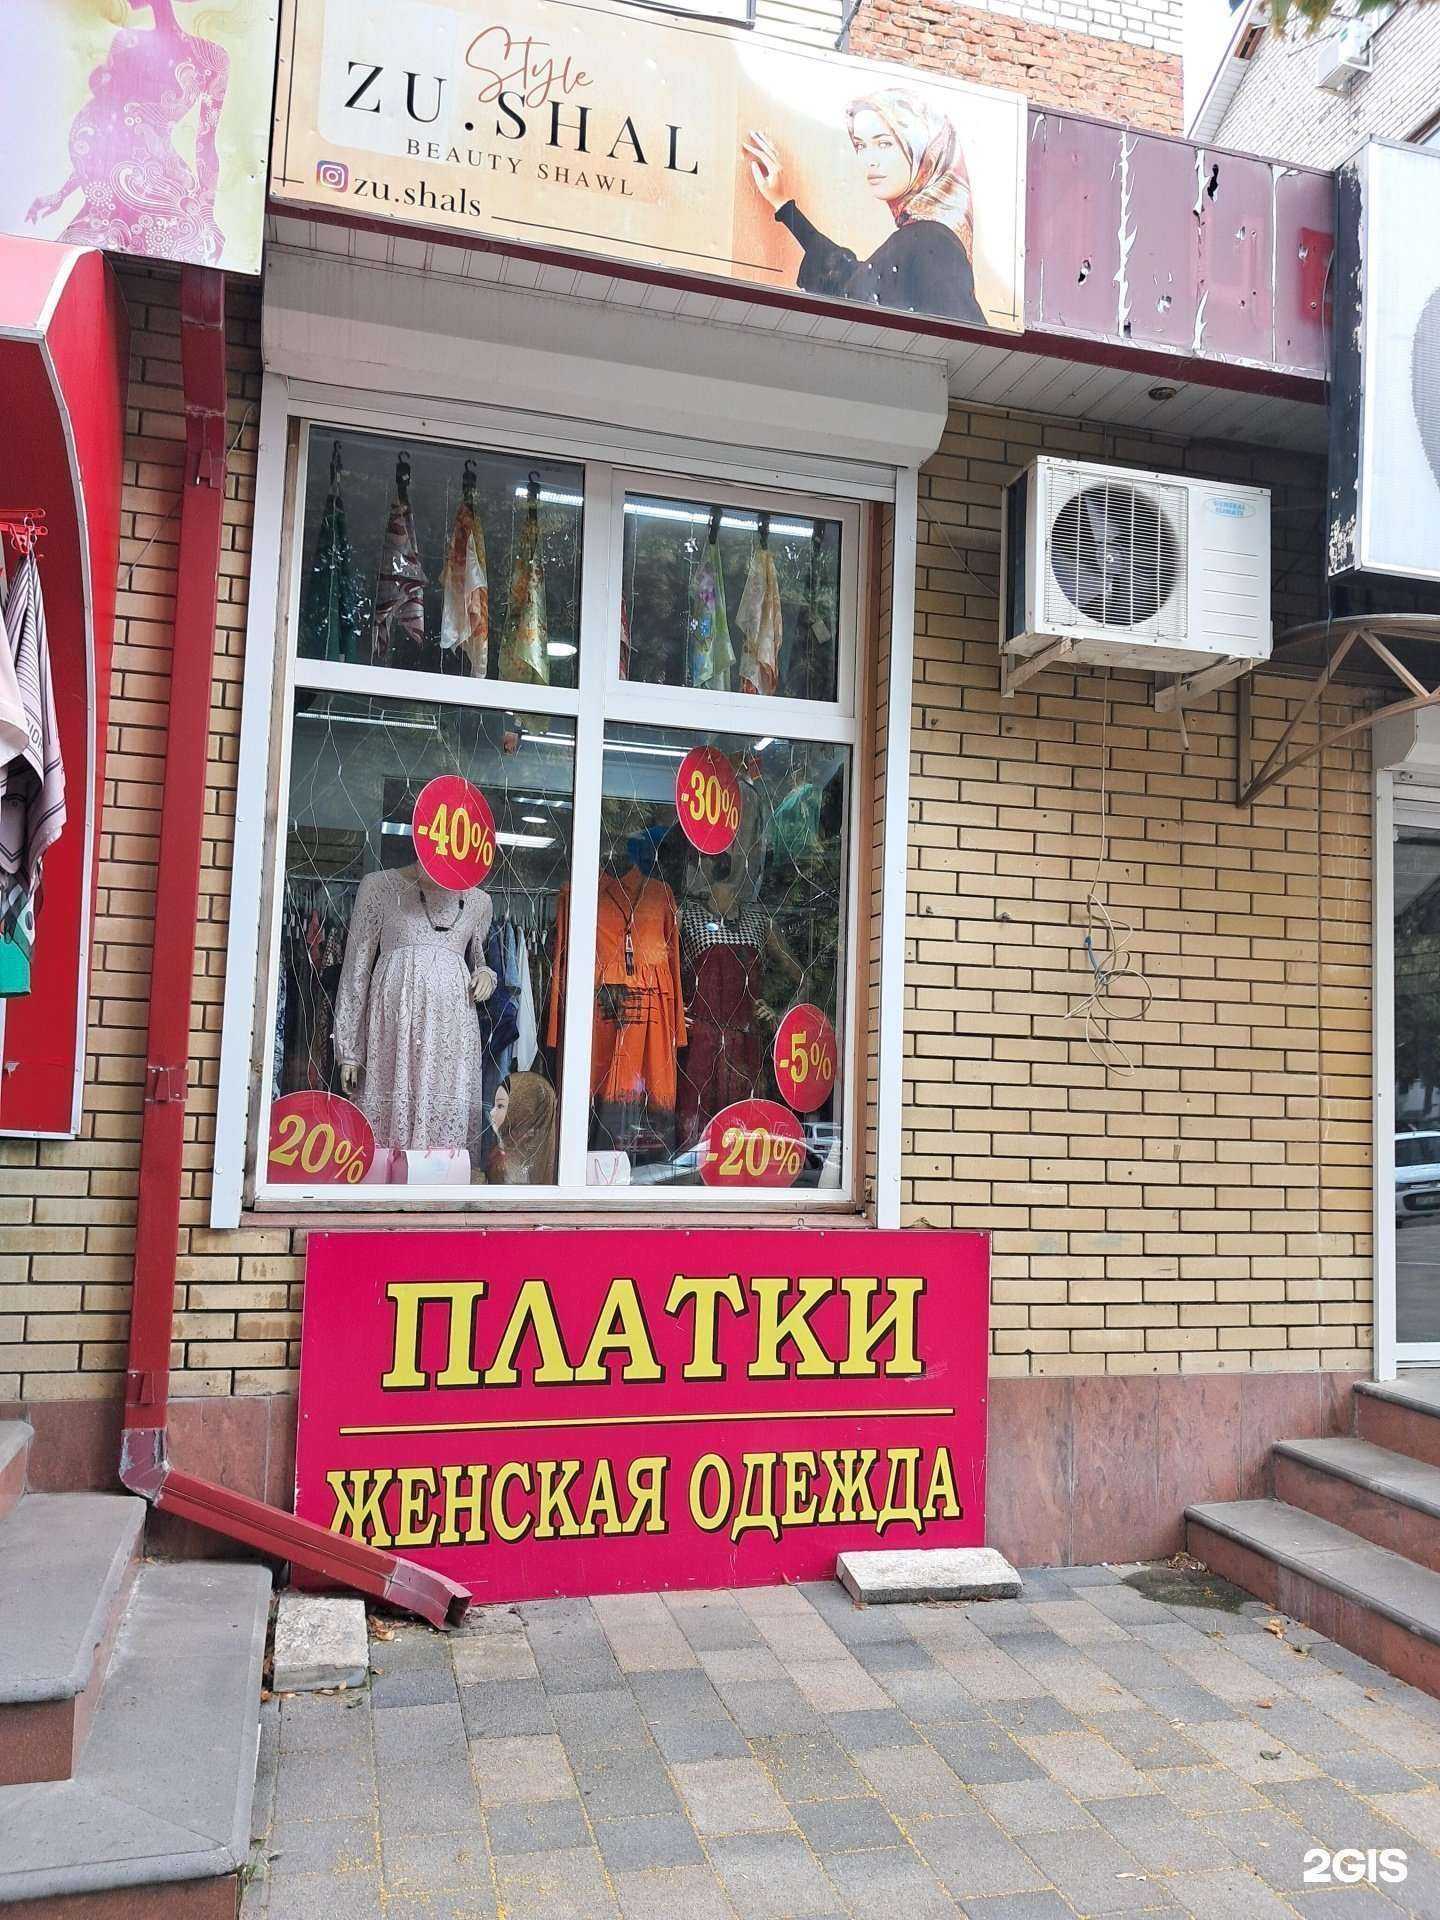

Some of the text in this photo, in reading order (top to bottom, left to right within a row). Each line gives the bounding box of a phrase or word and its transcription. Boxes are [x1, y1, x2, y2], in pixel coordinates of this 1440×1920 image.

[465, 26, 594, 107] Style
[344, 61, 699, 175] ZU.SHAL
[353, 177, 482, 218] zu.shals
[407, 138, 634, 196] BEAUTY SHAWL
[681, 770, 739, 829] -30%
[418, 804, 494, 867] -40%
[779, 1031, 832, 1083] -5%
[269, 1114, 364, 1184] 20%
[705, 1127, 800, 1177] -20%
[381, 1274, 926, 1392] ПЛАТКИ
[326, 1445, 964, 1551] ЖЕНСКАЯ ОДЕЖДА
